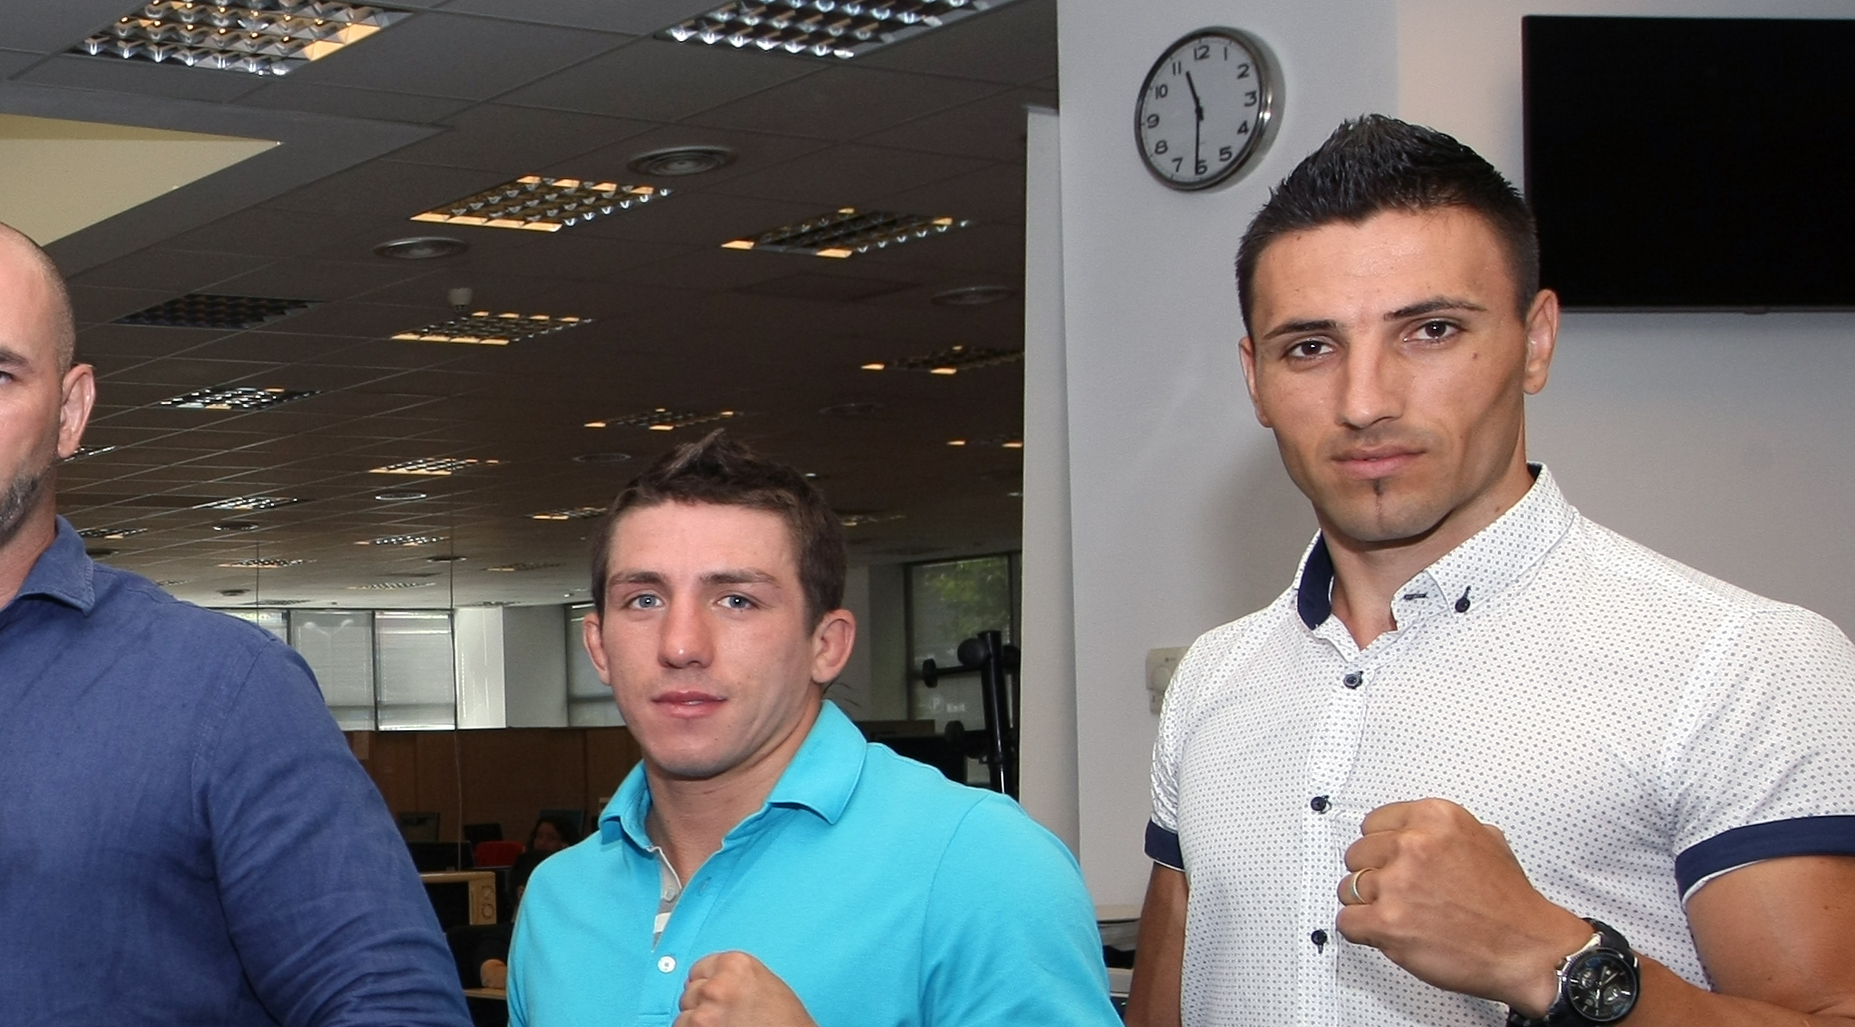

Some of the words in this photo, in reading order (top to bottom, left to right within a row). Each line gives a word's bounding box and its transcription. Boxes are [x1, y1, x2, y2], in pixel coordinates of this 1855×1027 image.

[1194, 45, 1210, 61] 12
[1223, 47, 1228, 61] 1
[1172, 61, 1182, 76] 11
[1237, 64, 1250, 79] 2
[1155, 84, 1168, 99] 10
[1244, 90, 1257, 107] 3
[1146, 114, 1160, 129] 9
[1237, 120, 1249, 135] 4
[1154, 140, 1168, 154] 8
[1219, 146, 1232, 162] 5
[1172, 157, 1183, 172] 7
[1195, 160, 1208, 175] 6
